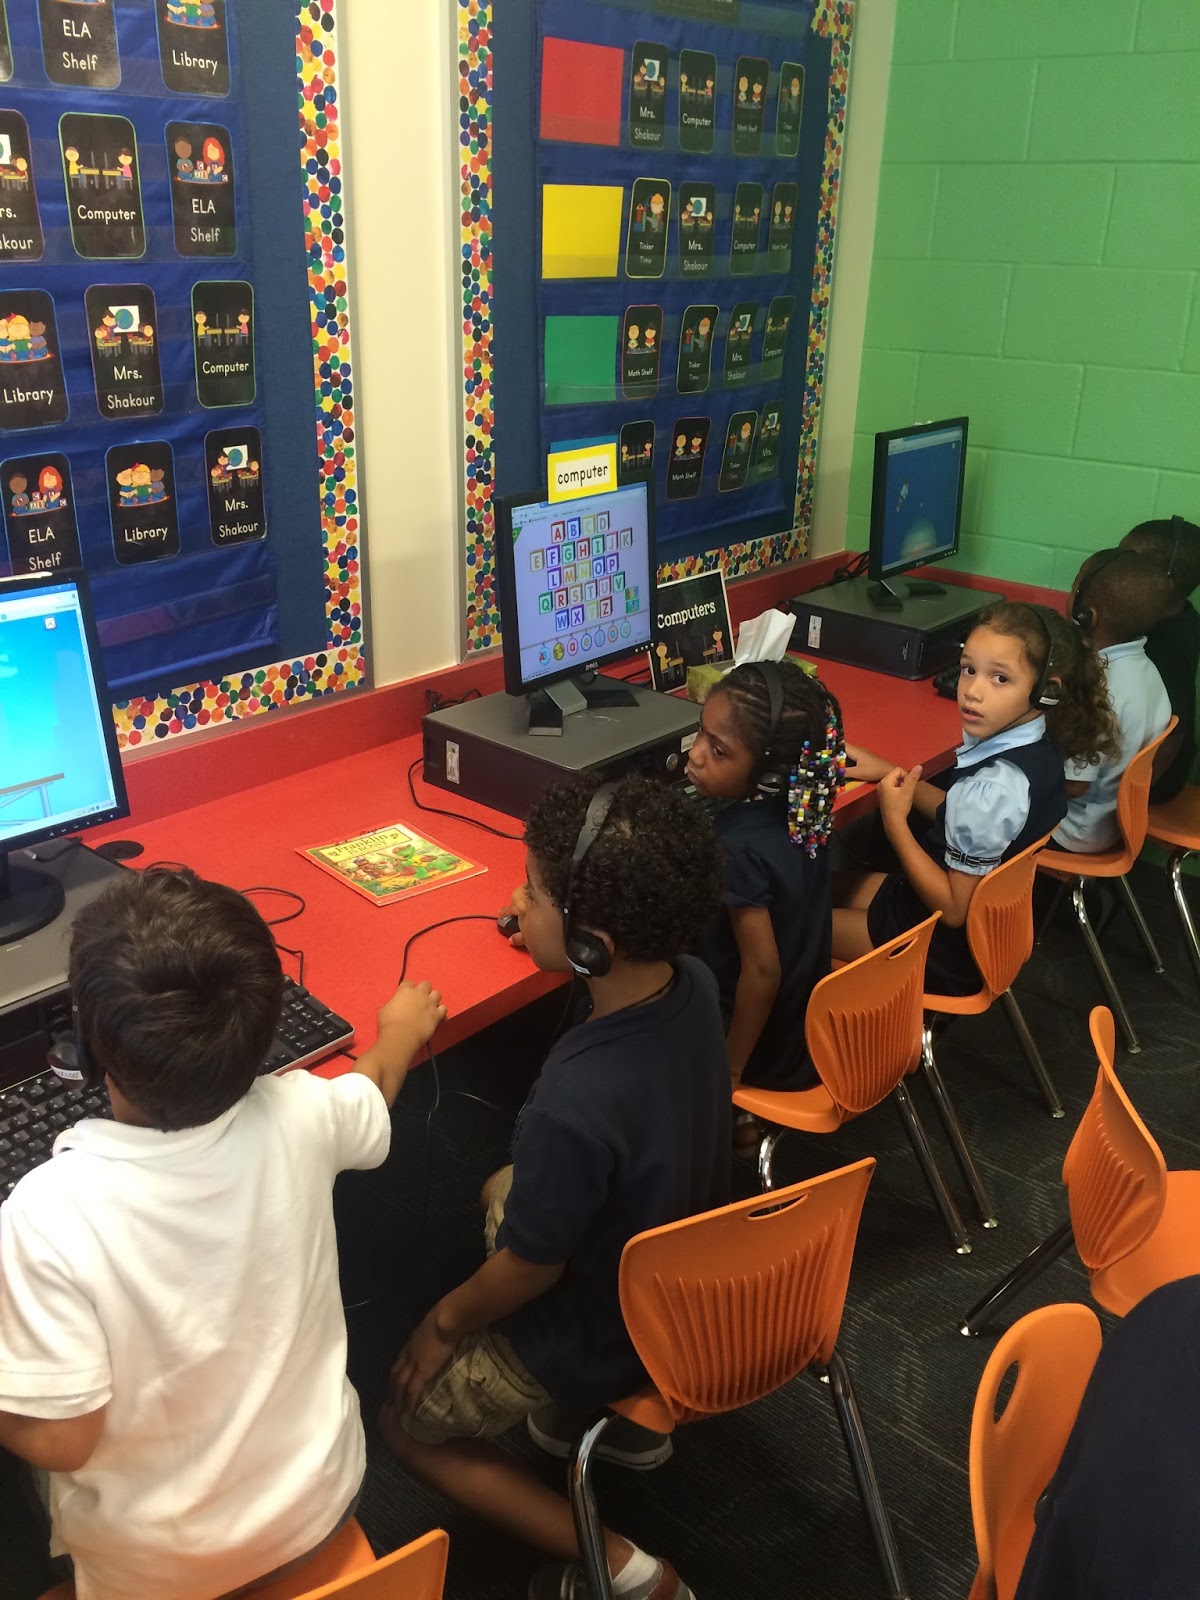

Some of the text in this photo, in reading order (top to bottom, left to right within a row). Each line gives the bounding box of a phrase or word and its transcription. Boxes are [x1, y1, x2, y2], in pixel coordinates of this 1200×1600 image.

[62, 19, 92, 38] ELA
[62, 52, 98, 70] Shelf
[172, 50, 218, 75] Library
[640, 106, 656, 118] Mrs.
[682, 113, 711, 128] Computer
[634, 128, 661, 141] Shakour
[0, 208, 16, 218] rs.
[192, 198, 216, 214] ELA
[78, 205, 136, 224] Computer
[0, 234, 33, 249] kour
[190, 227, 220, 242] Shelf
[639, 242, 654, 250] Tinker
[688, 240, 703, 250] Mrs.
[734, 240, 756, 253] Computer
[683, 261, 708, 271] Shakour
[732, 352, 743, 362] Mrs.
[114, 366, 142, 381] Mrs.
[202, 361, 249, 376] Computer
[642, 368, 654, 376] Shelf
[4, 387, 54, 404] Library
[107, 394, 155, 410] Shakour
[557, 464, 608, 487] computer
[225, 499, 249, 512] Mrs.
[28, 527, 55, 544] ELA
[124, 526, 168, 543] Library
[219, 521, 259, 538] Shakour
[29, 552, 62, 572] Shelf
[657, 601, 716, 629] Computers
[336, 834, 388, 852] Franklin
